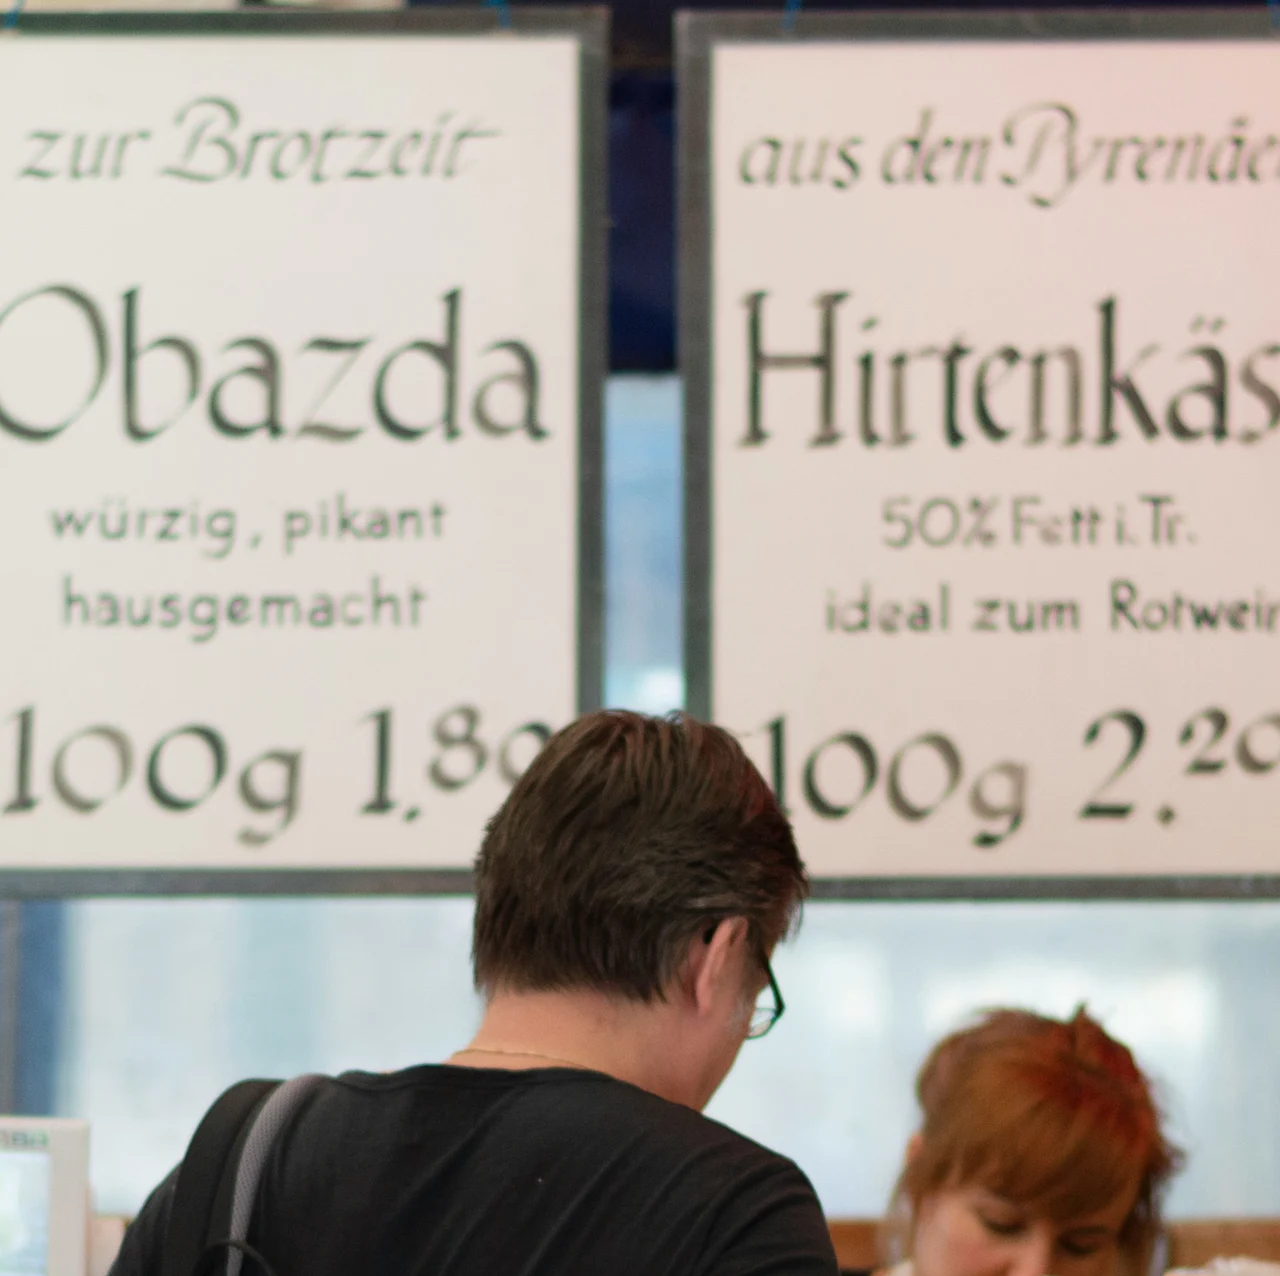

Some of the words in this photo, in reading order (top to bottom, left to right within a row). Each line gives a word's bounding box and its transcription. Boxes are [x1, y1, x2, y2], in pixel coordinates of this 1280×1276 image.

[16, 128, 152, 181] zur
[160, 95, 503, 186] Brotzeit
[736, 135, 865, 192] aus
[878, 107, 994, 188] den
[282, 493, 449, 556] pikant
[881, 495, 999, 551] 50%
[1011, 495, 1103, 548] Fett
[61, 575, 429, 645] hausgemacht
[824, 581, 952, 638] ideal
[970, 598, 1083, 638] zum
[1, 705, 305, 847] 100g
[754, 714, 1031, 849] 100g
